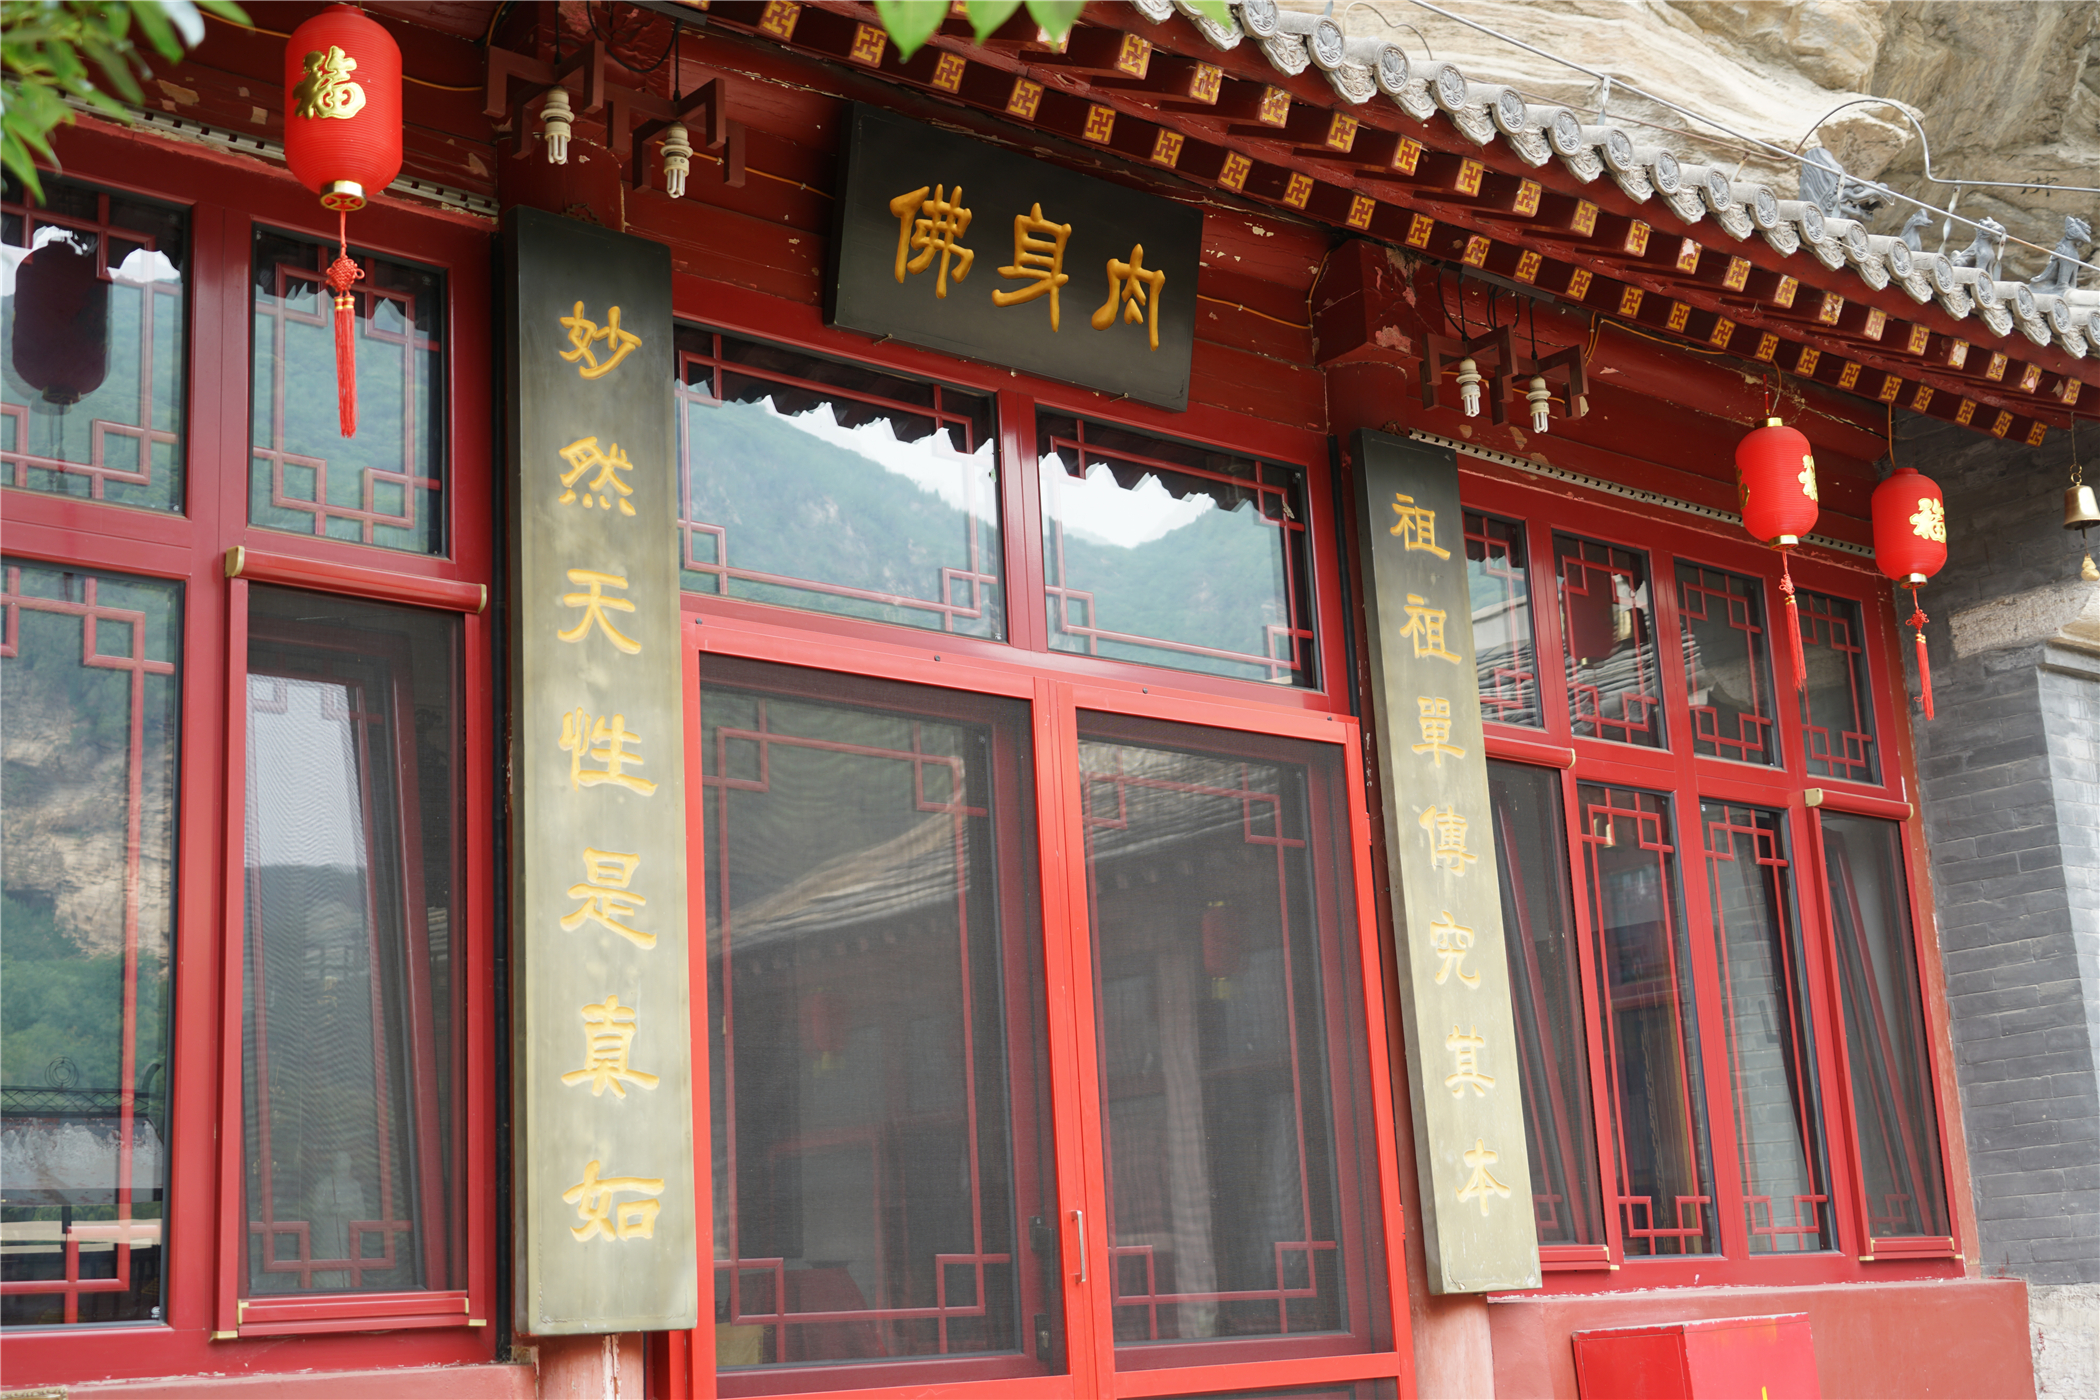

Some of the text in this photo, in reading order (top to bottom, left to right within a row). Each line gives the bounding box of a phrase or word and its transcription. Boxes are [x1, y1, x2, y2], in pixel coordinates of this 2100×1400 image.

[292, 45, 367, 119] 福
[1909, 497, 1947, 543] 福
[557, 300, 665, 1243] 妙然天性是真如
[1389, 491, 1512, 1217] 祖祖單傳究其本
